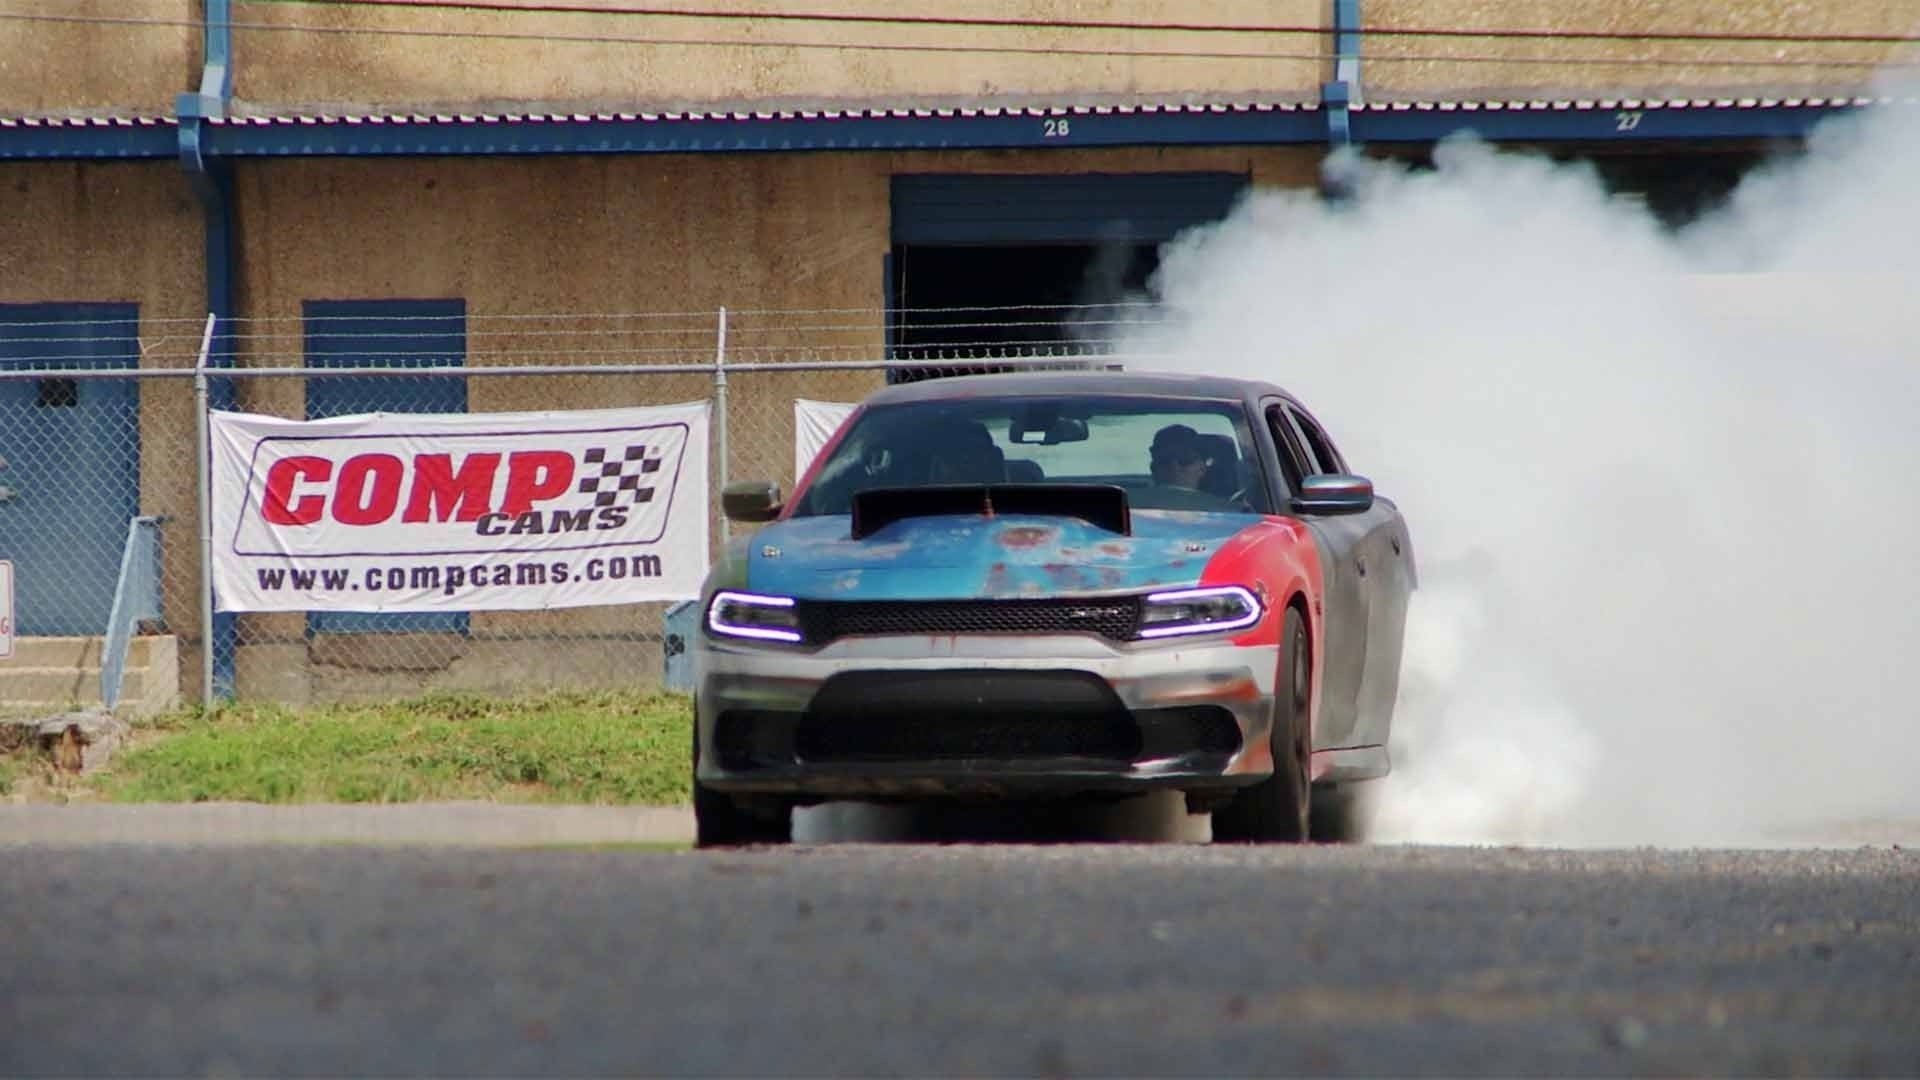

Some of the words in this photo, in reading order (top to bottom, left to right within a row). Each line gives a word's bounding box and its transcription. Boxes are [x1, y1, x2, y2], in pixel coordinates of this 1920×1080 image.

[1043, 118, 1070, 137] 28
[1616, 112, 1642, 130] 27
[261, 450, 576, 526] COMP
[476, 506, 630, 536] CAMS
[257, 554, 663, 596] www.compcams.com
